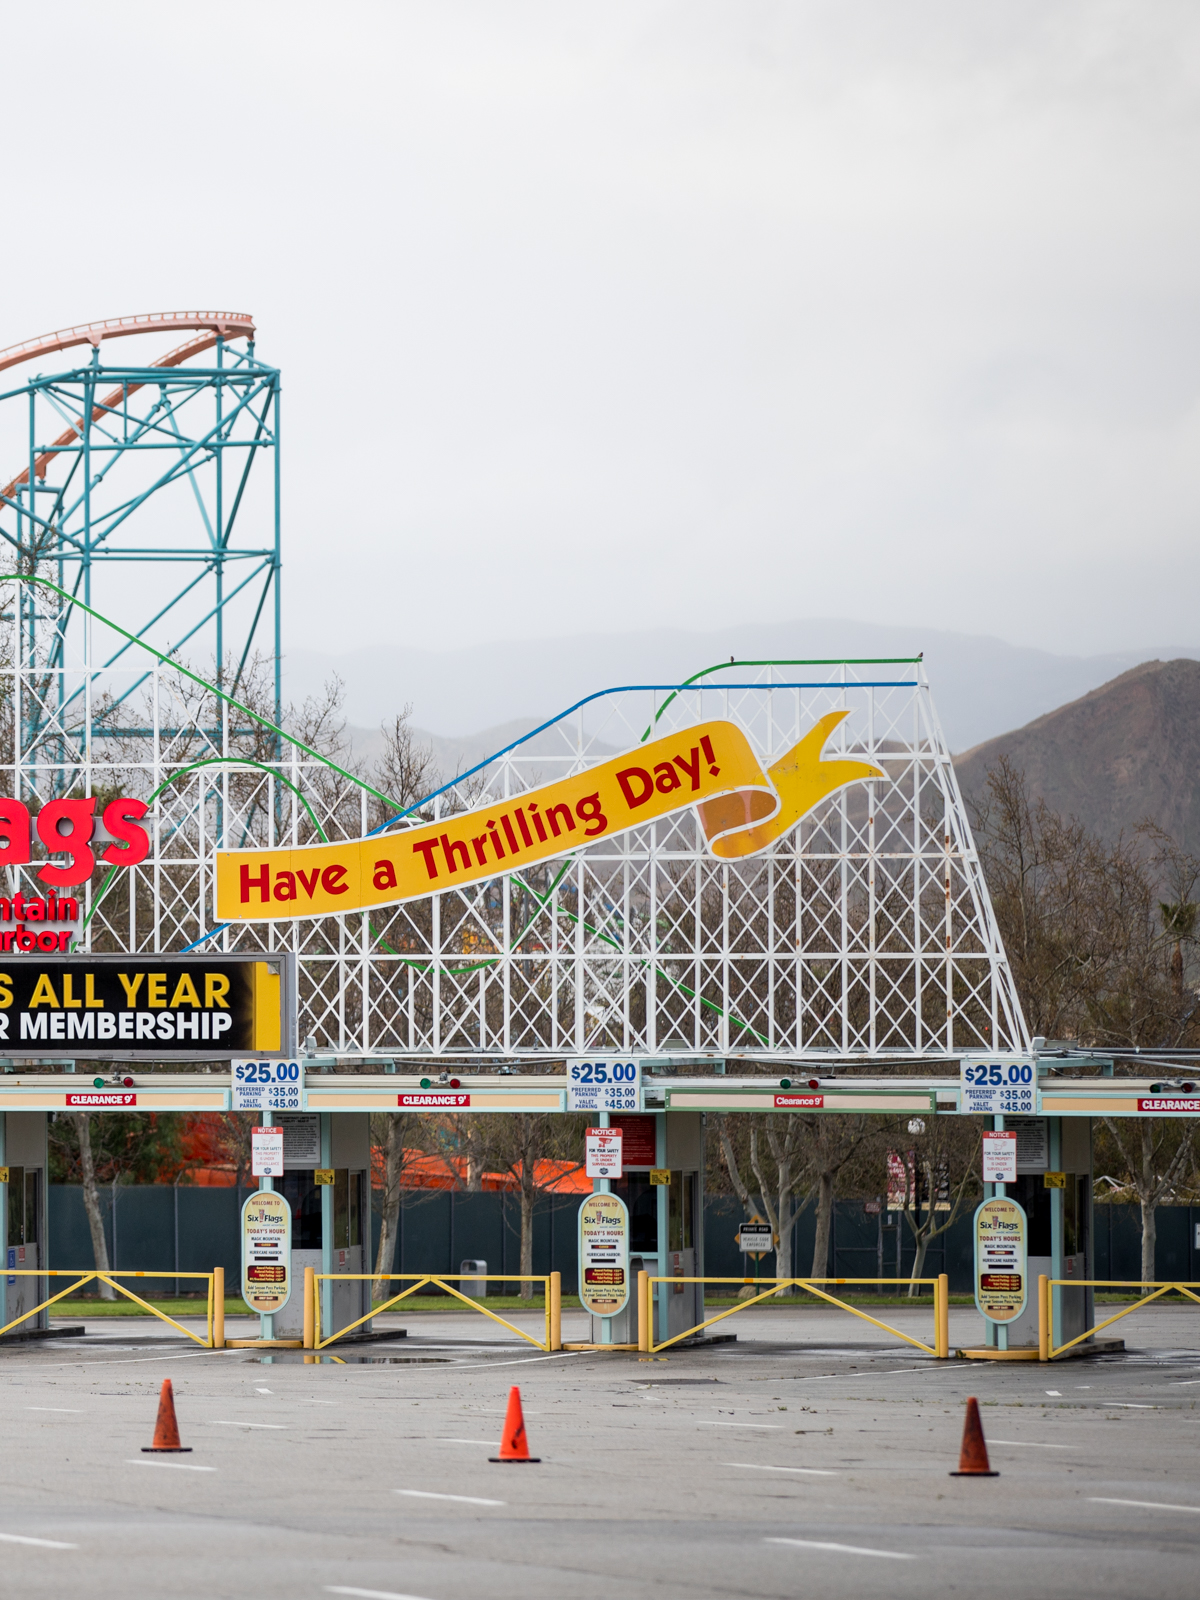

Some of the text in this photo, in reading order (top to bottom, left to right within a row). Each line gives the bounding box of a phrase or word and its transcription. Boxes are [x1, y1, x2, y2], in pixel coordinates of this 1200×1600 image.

[240, 735, 719, 903] Have a Thrilling Day!
[29, 974, 103, 1007] ALL
[118, 974, 229, 1007] YEAR
[21, 1012, 232, 1039] MEMBERSHIP
[236, 1063, 299, 1083] $25.00
[571, 1063, 636, 1083] $25.00
[965, 1065, 1032, 1085] $25.00
[269, 1087, 298, 1096] $35.00
[605, 1088, 635, 1097] $35.00
[1000, 1090, 1031, 1099] $35.00
[71, 1095, 132, 1104] CLEARANCE 9'
[269, 1099, 298, 1108] $45.00
[402, 1096, 466, 1104] CLEARANCE 9'
[605, 1099, 635, 1108] $45.00
[776, 1097, 822, 1105] Clearance 9'
[1000, 1102, 1031, 1111] $45.00
[1142, 1100, 1200, 1109] CLEARANCE
[264, 1215, 282, 1223] Flags
[602, 1216, 620, 1225] Flags
[998, 1222, 1018, 1230] Flags
